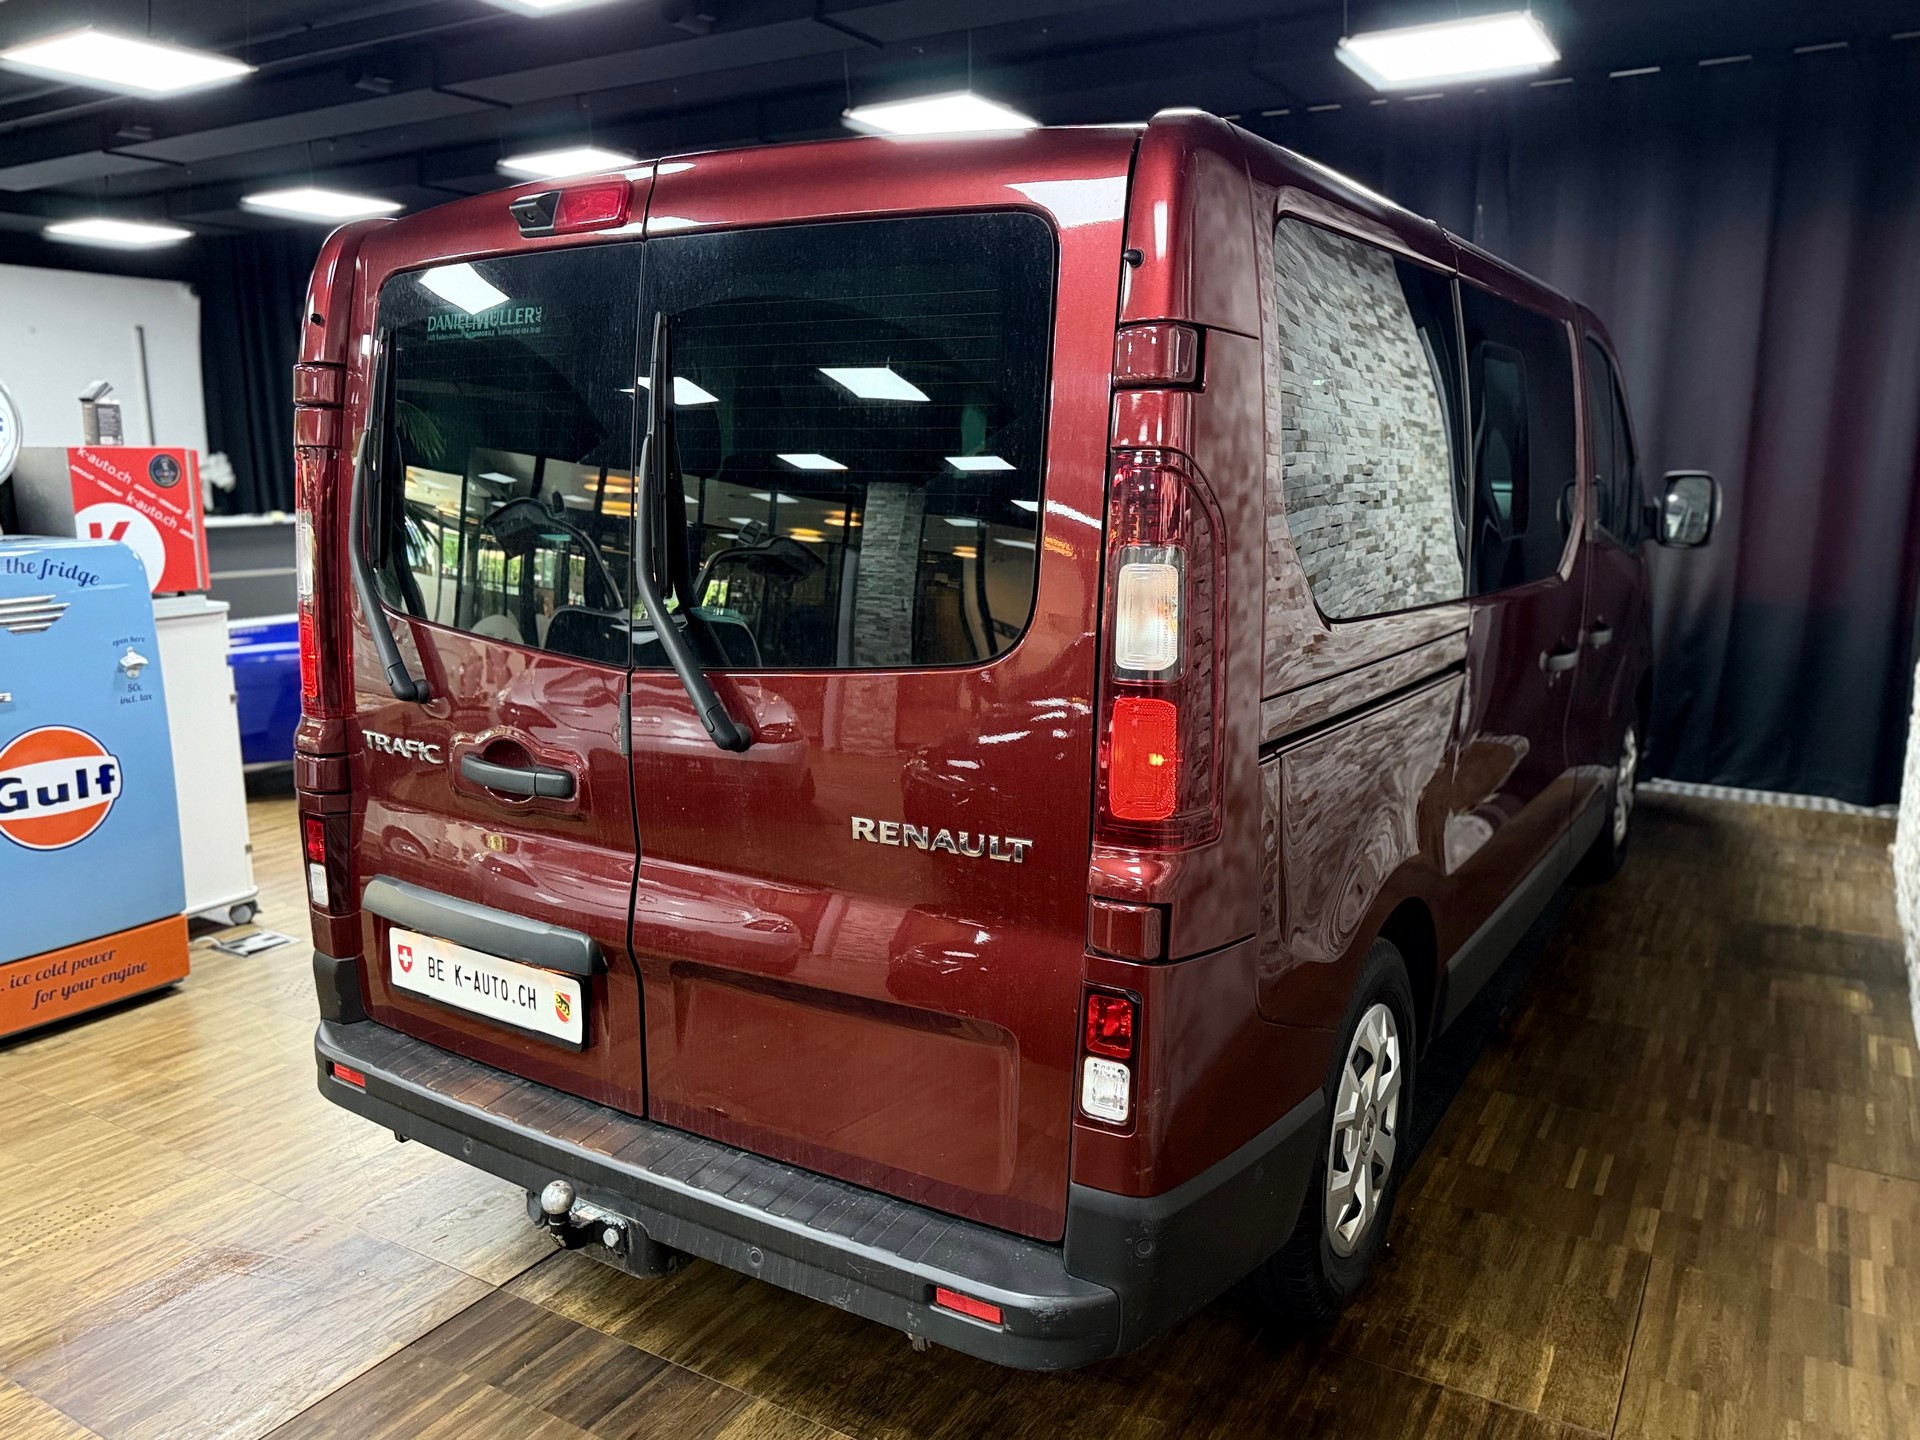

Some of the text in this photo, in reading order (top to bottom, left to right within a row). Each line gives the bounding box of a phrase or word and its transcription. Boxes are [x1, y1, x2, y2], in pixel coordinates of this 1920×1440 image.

[77, 446, 132, 484] k-auto.ch
[126, 491, 178, 529] k-auto.ch
[6, 557, 100, 587] the fridge
[112, 635, 146, 647] open here
[361, 729, 444, 764] TRAFIC
[0, 763, 116, 814] Gulf
[850, 815, 1034, 864] RENAULT
[10, 949, 117, 989] ice cold power
[31, 961, 149, 1010] for your engine
[428, 955, 537, 1011] BE K-AUTO.CH
